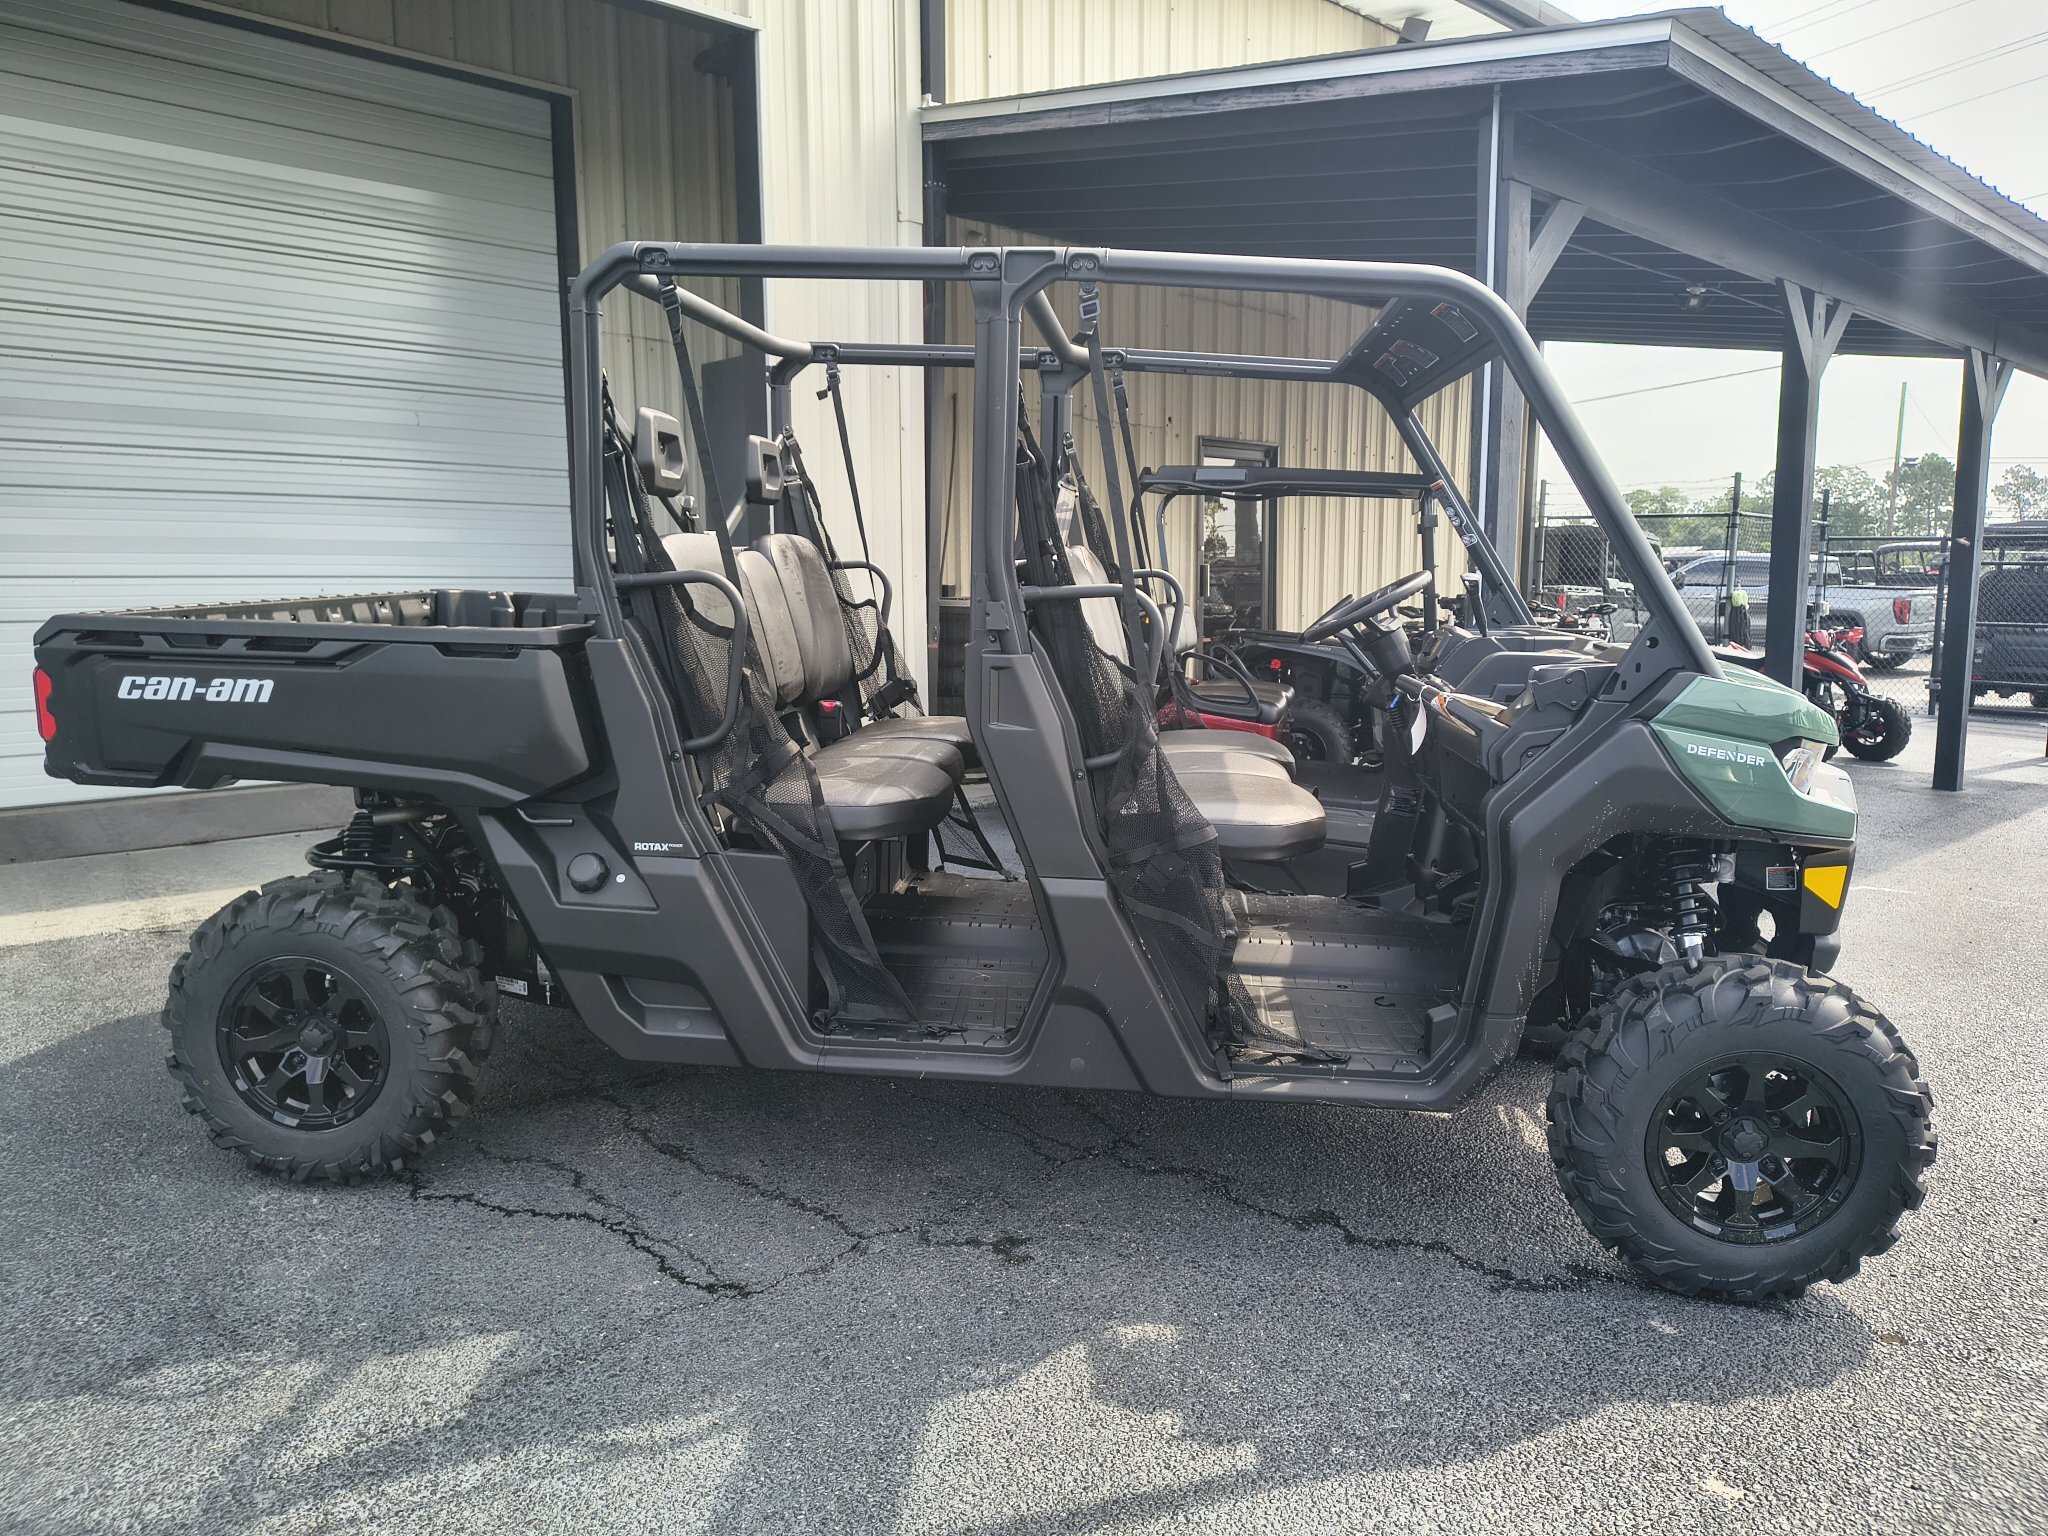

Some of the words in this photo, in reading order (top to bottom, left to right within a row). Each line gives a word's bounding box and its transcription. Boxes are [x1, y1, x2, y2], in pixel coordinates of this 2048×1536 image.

[117, 675, 274, 703] can-am
[1687, 743, 1766, 767] DEFENDER
[634, 842, 669, 851] ROTAX
